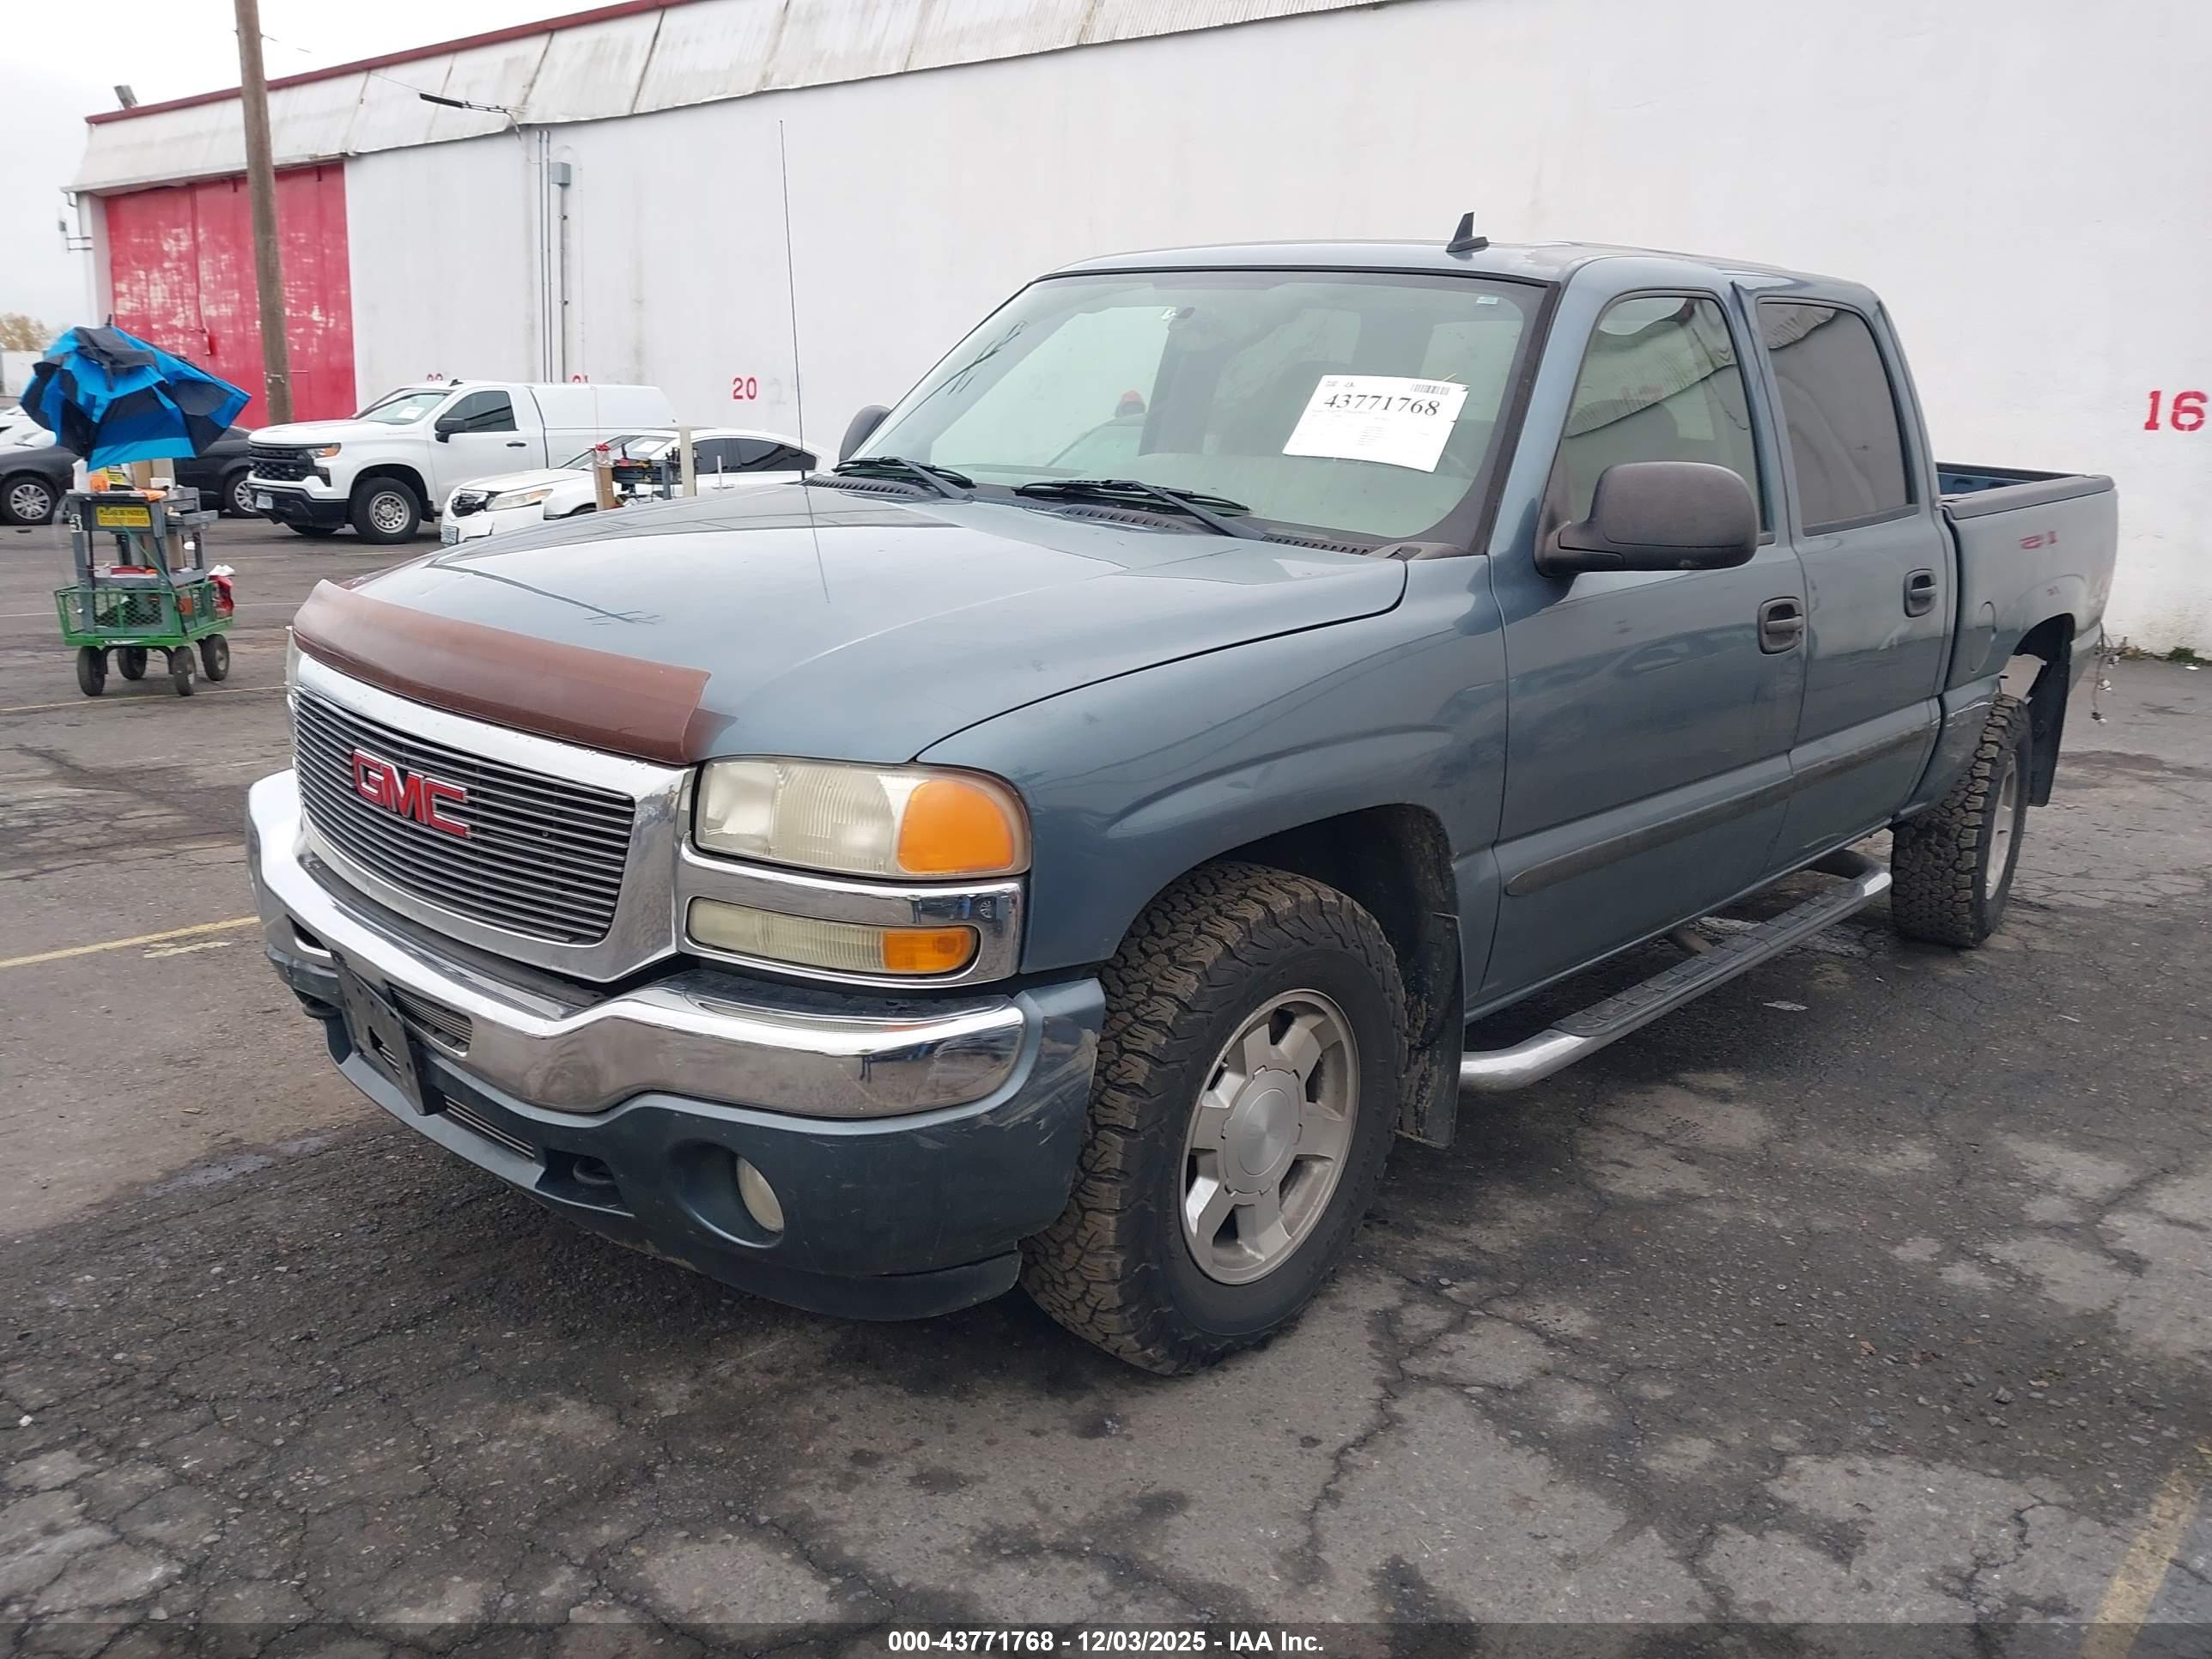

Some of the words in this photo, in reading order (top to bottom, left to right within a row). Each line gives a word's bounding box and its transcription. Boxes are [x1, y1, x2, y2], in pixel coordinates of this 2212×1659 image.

[732, 376, 757, 400] 20
[1323, 393, 1441, 416] 43771768
[2143, 391, 2209, 432] 16
[352, 748, 471, 840] GMC
